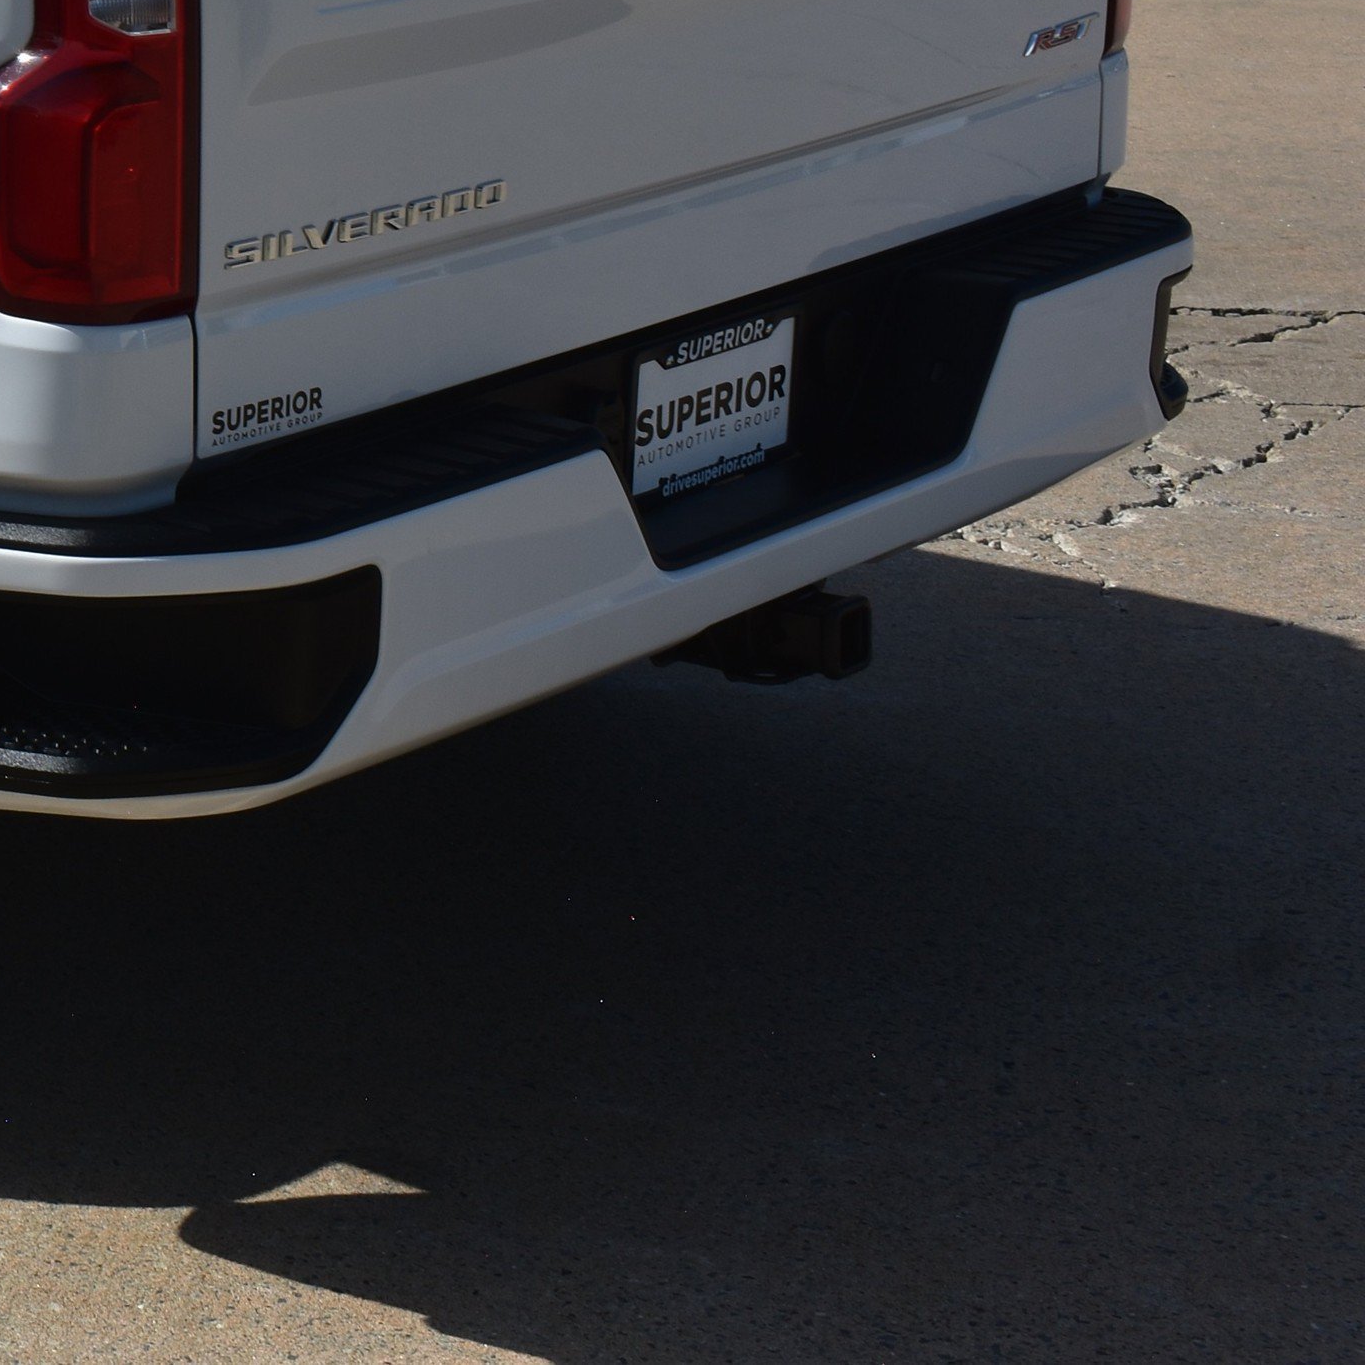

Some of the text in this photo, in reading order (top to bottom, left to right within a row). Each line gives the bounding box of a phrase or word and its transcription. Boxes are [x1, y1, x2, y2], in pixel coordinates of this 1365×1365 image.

[1023, 11, 1100, 57] RST
[224, 178, 508, 270] SILVERADO
[677, 318, 765, 365] SUPERIOR
[212, 387, 323, 435] SUPERIOR
[212, 412, 323, 447] AUTOMOTIVE GROUP
[634, 365, 786, 447] SUPERIOR
[637, 407, 781, 467] AUTOMOTIVE GROUP
[662, 449, 766, 497] drivesuperior.com
